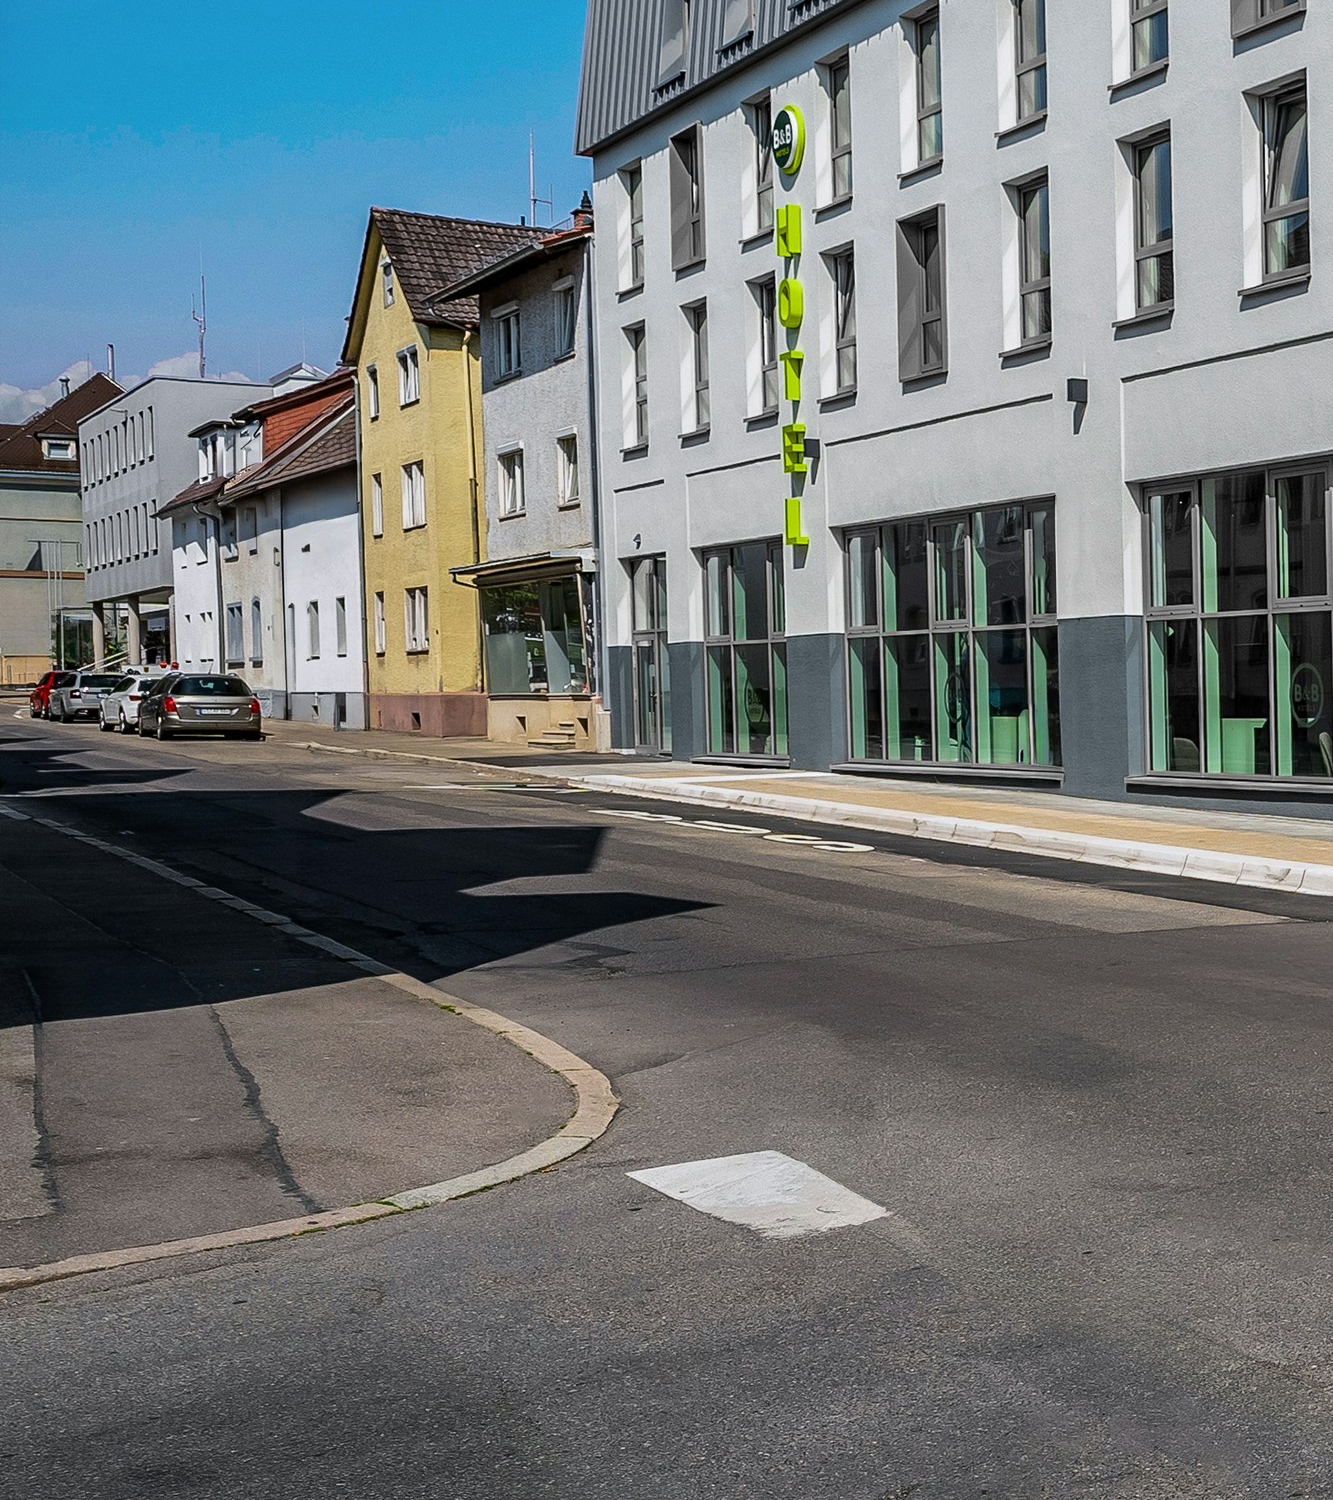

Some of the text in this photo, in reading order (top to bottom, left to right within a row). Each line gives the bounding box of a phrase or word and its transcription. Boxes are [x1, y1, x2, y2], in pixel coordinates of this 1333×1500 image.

[773, 123, 792, 150] B&B
[776, 203, 809, 546] HOTEL
[587, 809, 876, 853] BUS
